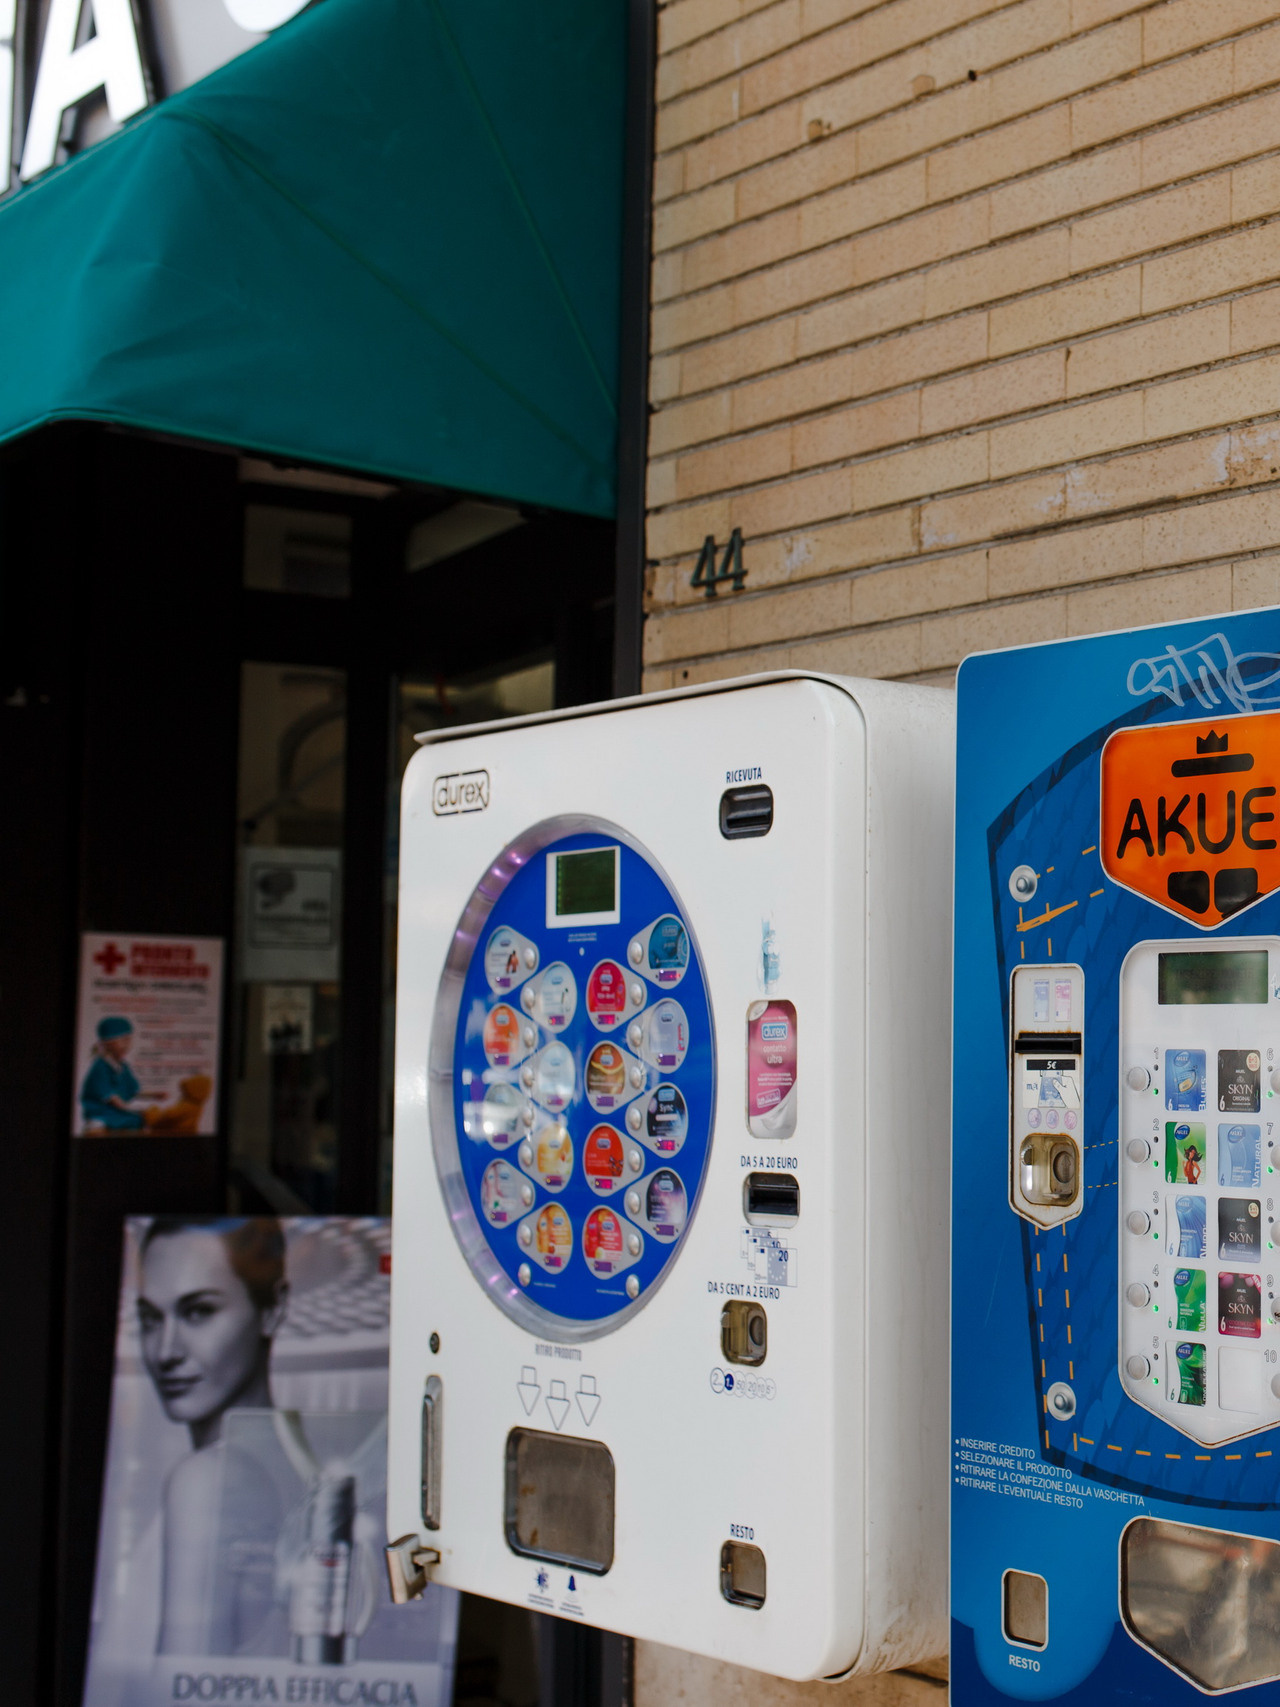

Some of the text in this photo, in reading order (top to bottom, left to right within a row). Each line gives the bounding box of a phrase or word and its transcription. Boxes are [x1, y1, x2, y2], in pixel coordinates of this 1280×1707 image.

[690, 527, 748, 597] 44
[726, 766, 762, 784] RICEVUTA
[437, 777, 488, 808] durex
[762, 1024, 788, 1039] durex
[767, 1054, 783, 1064] ultra
[1046, 1060, 1057, 1070] 5€
[1228, 1083, 1254, 1095] SKYN
[1168, 1098, 1173, 1111] 6
[1219, 1095, 1226, 1111] 6
[1152, 1118, 1159, 1131] 2
[1266, 1122, 1274, 1136] 7
[740, 1155, 798, 1169] DA 5 A 20 EURO
[1252, 1136, 1261, 1188] NATURAL
[1167, 1171, 1172, 1183] 6
[1220, 1173, 1225, 1186] 6
[1152, 1190, 1159, 1203] 3
[1266, 1197, 1274, 1211] 8
[1228, 1231, 1254, 1243] SKYN
[778, 1250, 789, 1262] 20
[1168, 1242, 1174, 1256] 6
[1220, 1242, 1226, 1258] 6
[1152, 1264, 1159, 1276] 4
[1266, 1274, 1274, 1287] 9
[707, 1281, 780, 1300] DA 5 CENT A 2 EURO
[1228, 1302, 1254, 1315] SKYN
[1167, 1316, 1173, 1329] 6
[1220, 1316, 1226, 1332] 6
[1152, 1335, 1159, 1349] 5
[1264, 1349, 1277, 1364] 10
[1170, 1388, 1175, 1400] 6
[960, 1438, 1035, 1459] INSERIRE CREDITO
[960, 1451, 1072, 1479] SELEZIONARE IL PRODOTTO
[960, 1464, 1145, 1506] RITIRARE LA CONFEZIONE DALLA VASCHETTA
[960, 1477, 1083, 1509] RITIRARE L'EVENTUALE RESTO
[730, 1523, 755, 1540] RESTO
[1009, 1654, 1040, 1672] RESTO
[173, 1672, 418, 1707] DOPPIA EFFICACIA
